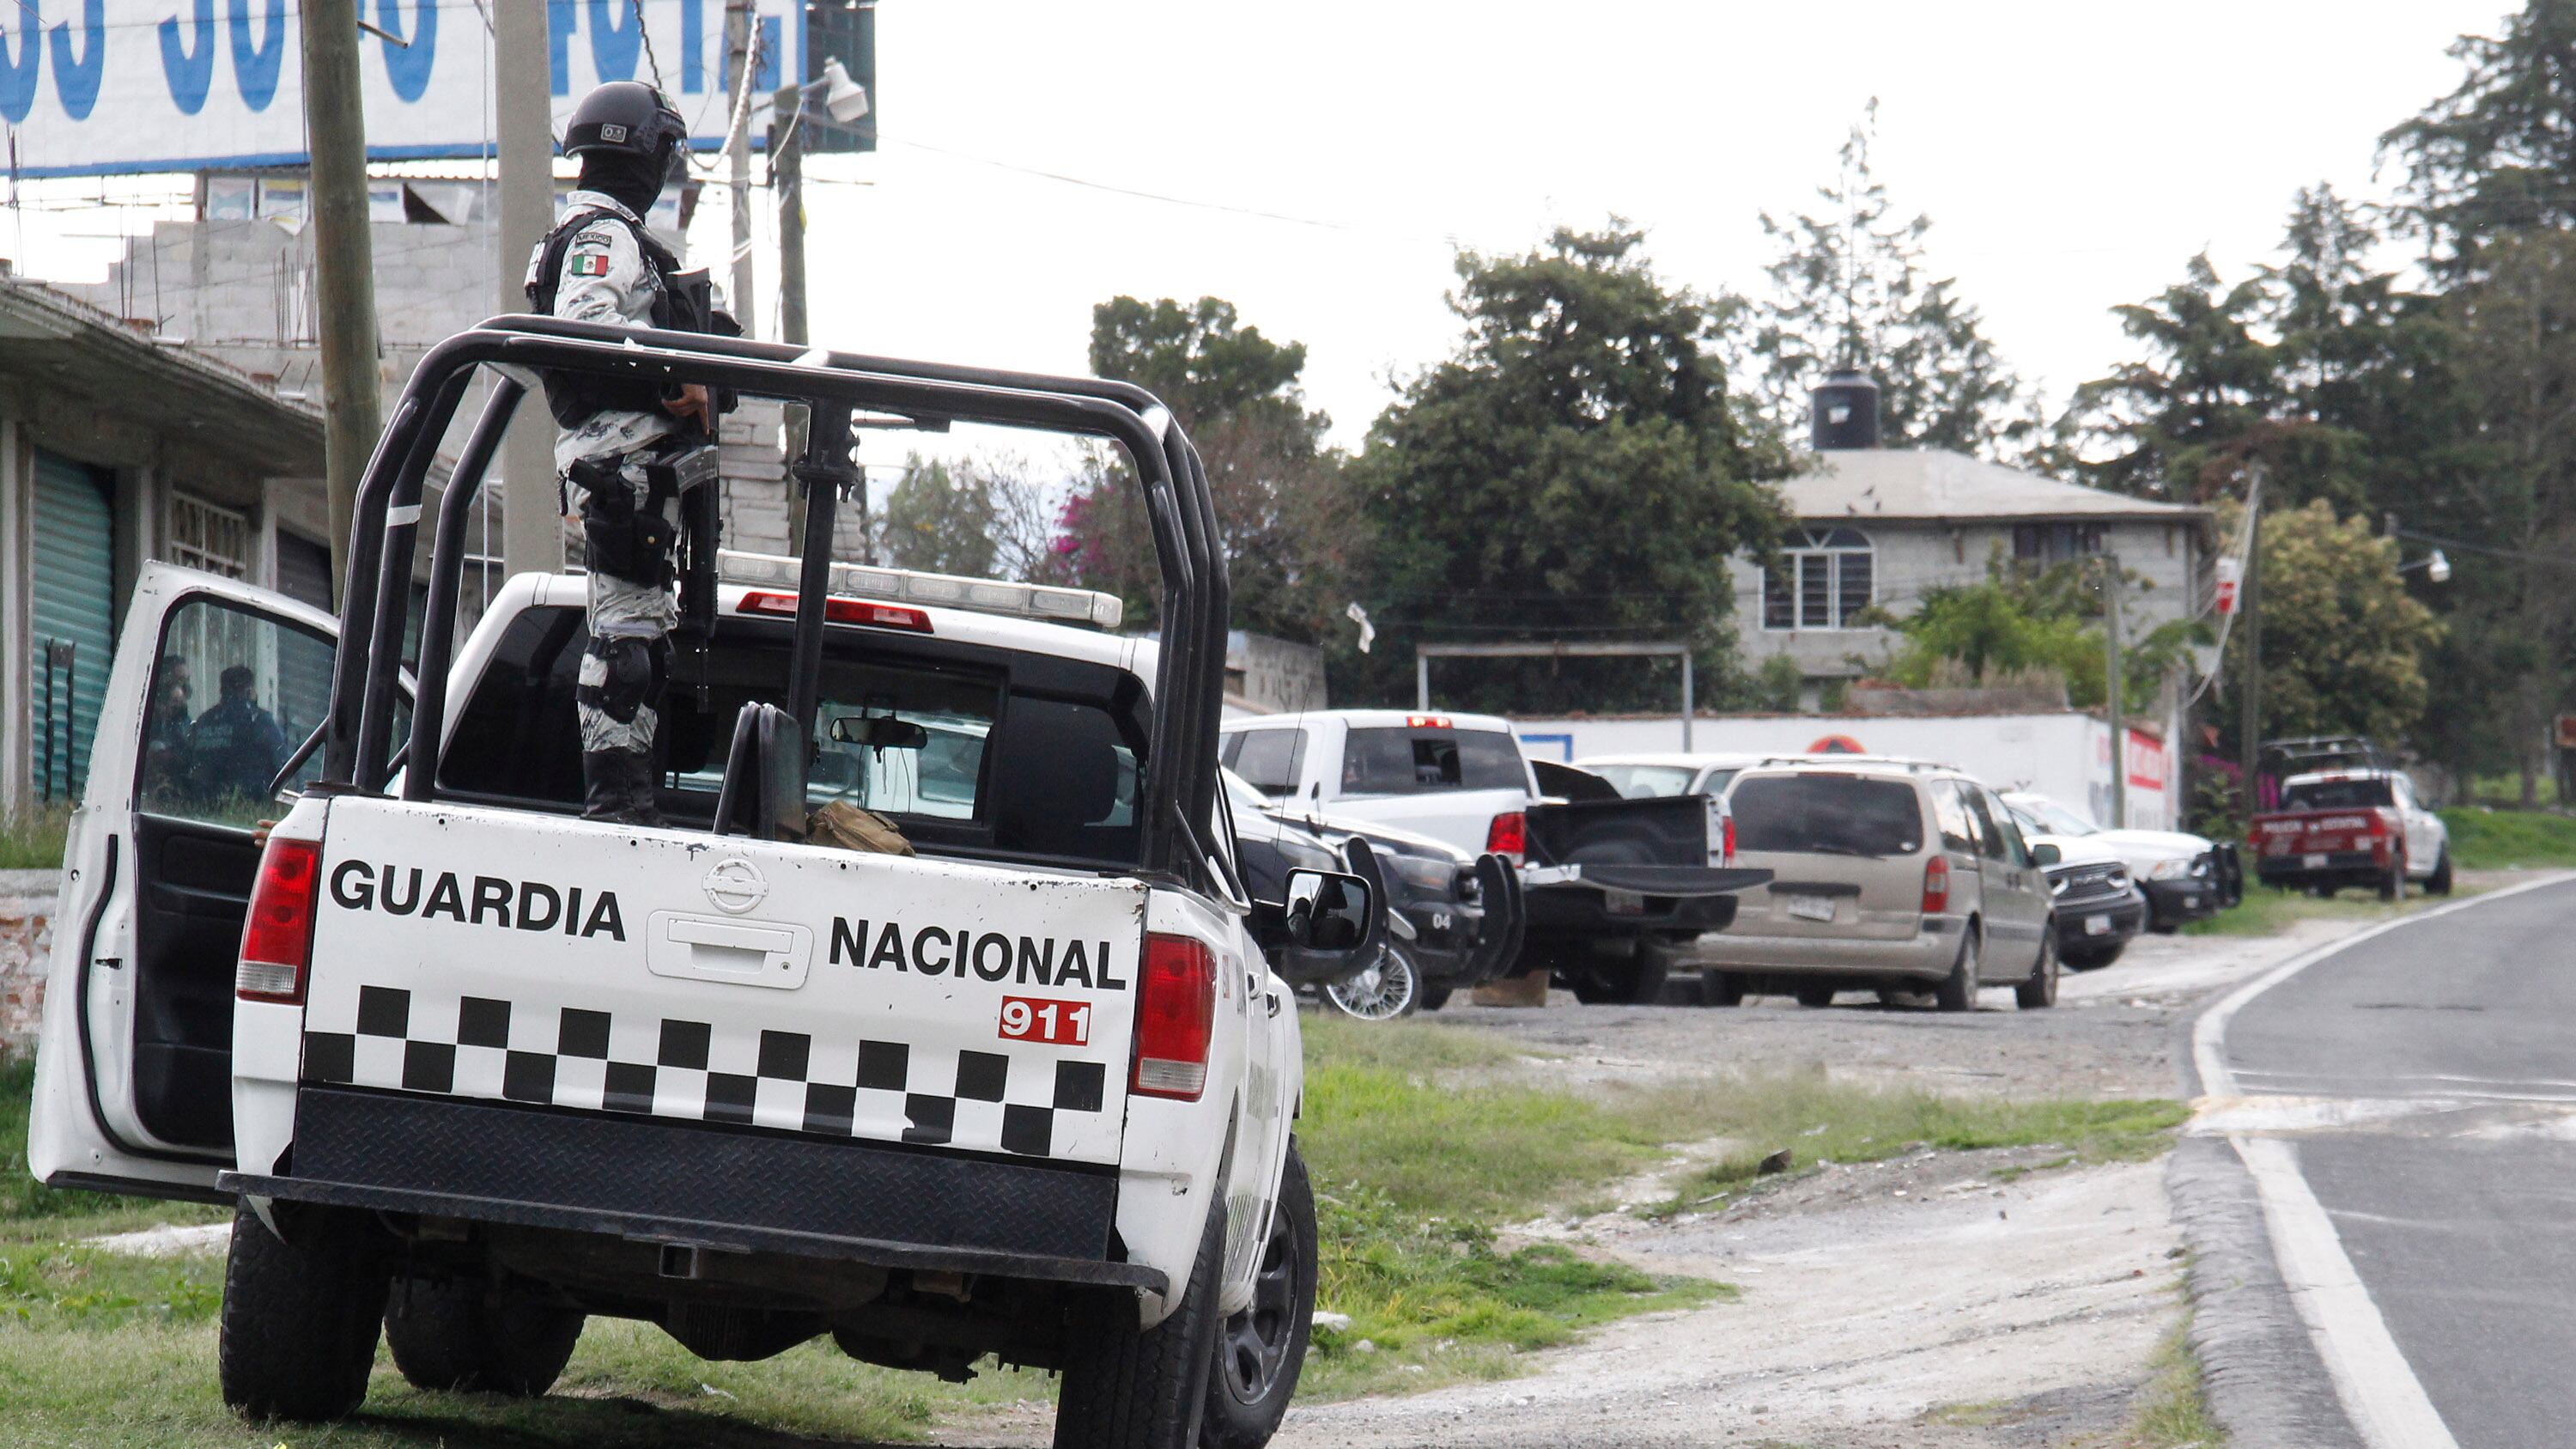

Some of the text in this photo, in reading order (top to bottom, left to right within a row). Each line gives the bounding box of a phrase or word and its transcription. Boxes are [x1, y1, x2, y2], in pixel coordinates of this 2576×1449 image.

[578, 233, 610, 244] MEXICO
[330, 859, 1127, 990] GUARDIA NACIONAL
[1432, 913, 1451, 929] 04
[1002, 1001, 1090, 1041] 911
